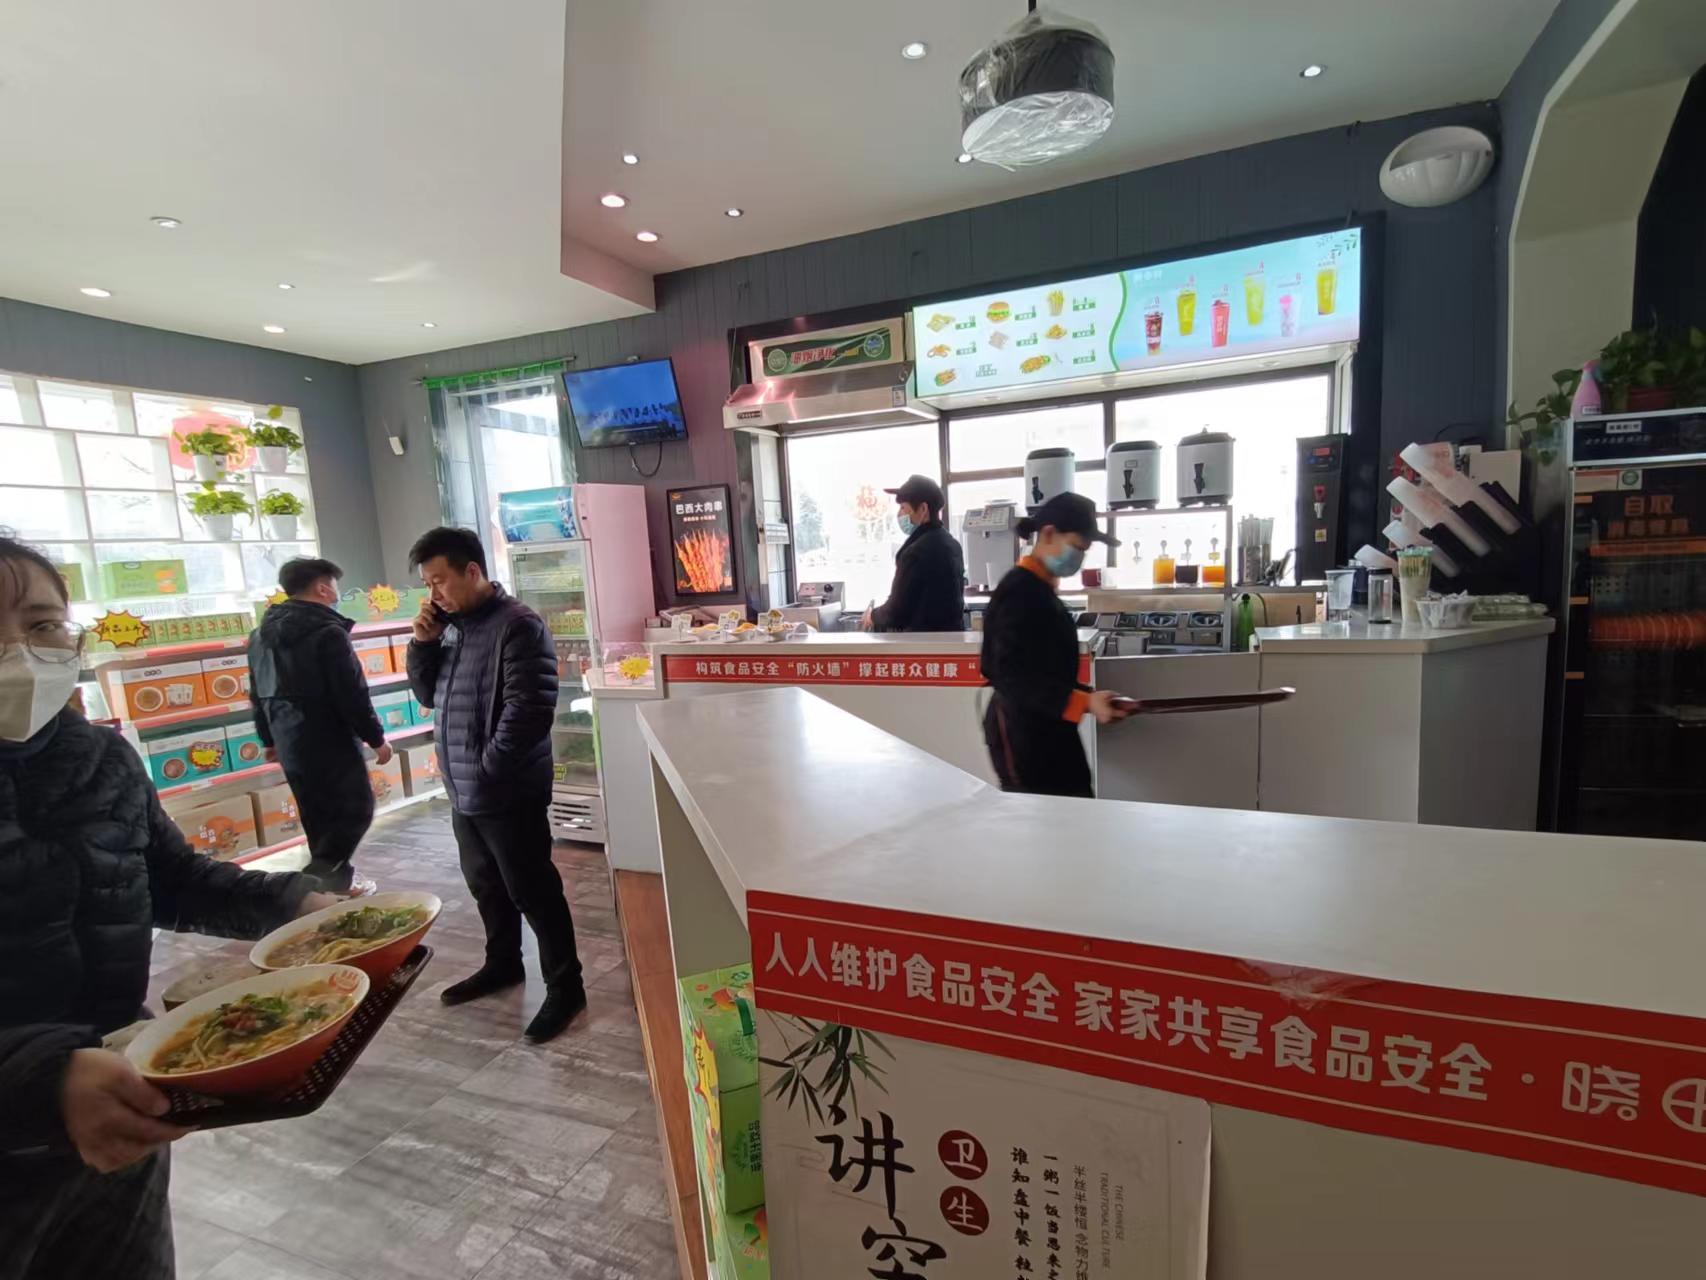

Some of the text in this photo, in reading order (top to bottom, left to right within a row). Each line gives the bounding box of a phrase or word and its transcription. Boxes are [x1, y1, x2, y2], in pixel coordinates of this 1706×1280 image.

[765, 932, 1060, 1023] 人人维护食品安全
[1075, 980, 1492, 1101] 家家共享食品安全
